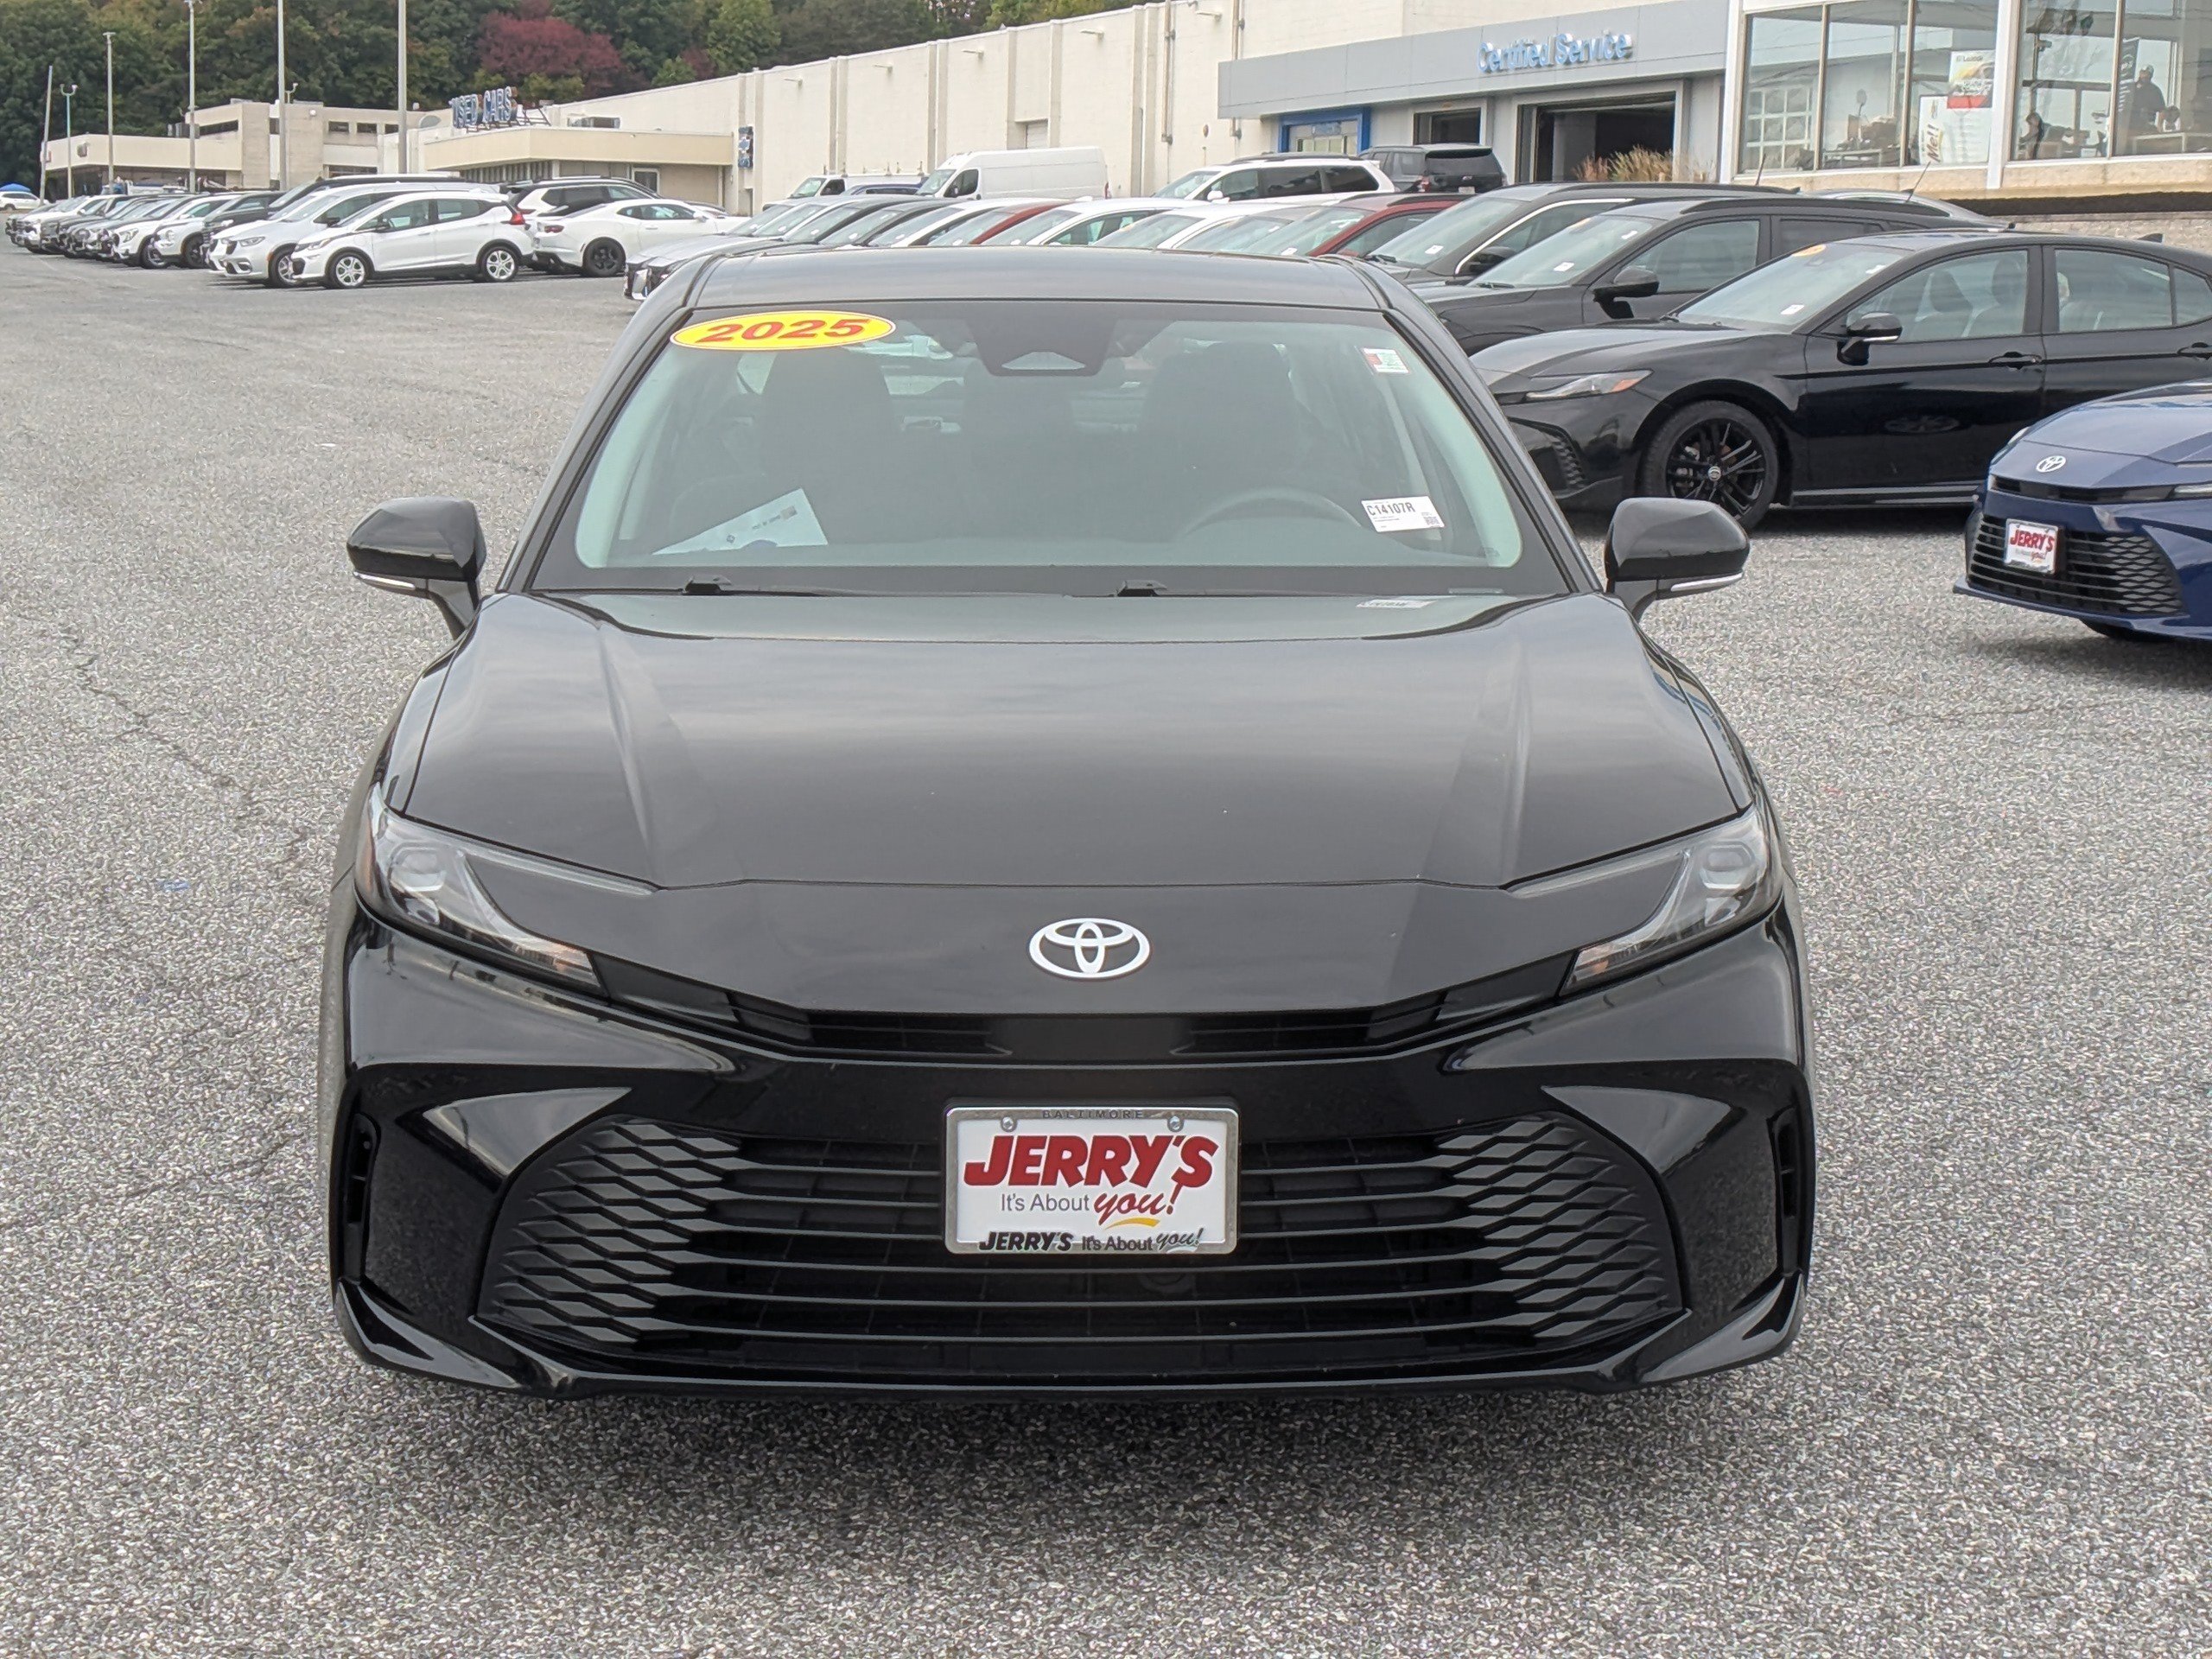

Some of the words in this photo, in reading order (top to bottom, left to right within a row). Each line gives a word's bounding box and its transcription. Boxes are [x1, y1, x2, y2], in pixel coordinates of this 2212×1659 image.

[1477, 37, 1554, 73] Certified
[1555, 29, 1632, 66] Service
[448, 93, 479, 128] USED
[483, 86, 514, 124] CARS
[694, 318, 871, 344] 2025
[1366, 502, 1416, 516] C14107R
[2010, 529, 2055, 552] JERRY'S
[1042, 1109, 1144, 1120] BALTIMORE
[963, 1135, 1219, 1188] JERRY'S
[1001, 1193, 1026, 1211] It's
[1030, 1192, 1090, 1211] About
[1093, 1181, 1183, 1226] you!
[979, 1231, 1075, 1252] JERRY'S
[1082, 1236, 1102, 1251] It's
[1105, 1235, 1154, 1251] About
[1156, 1227, 1204, 1249] you!
